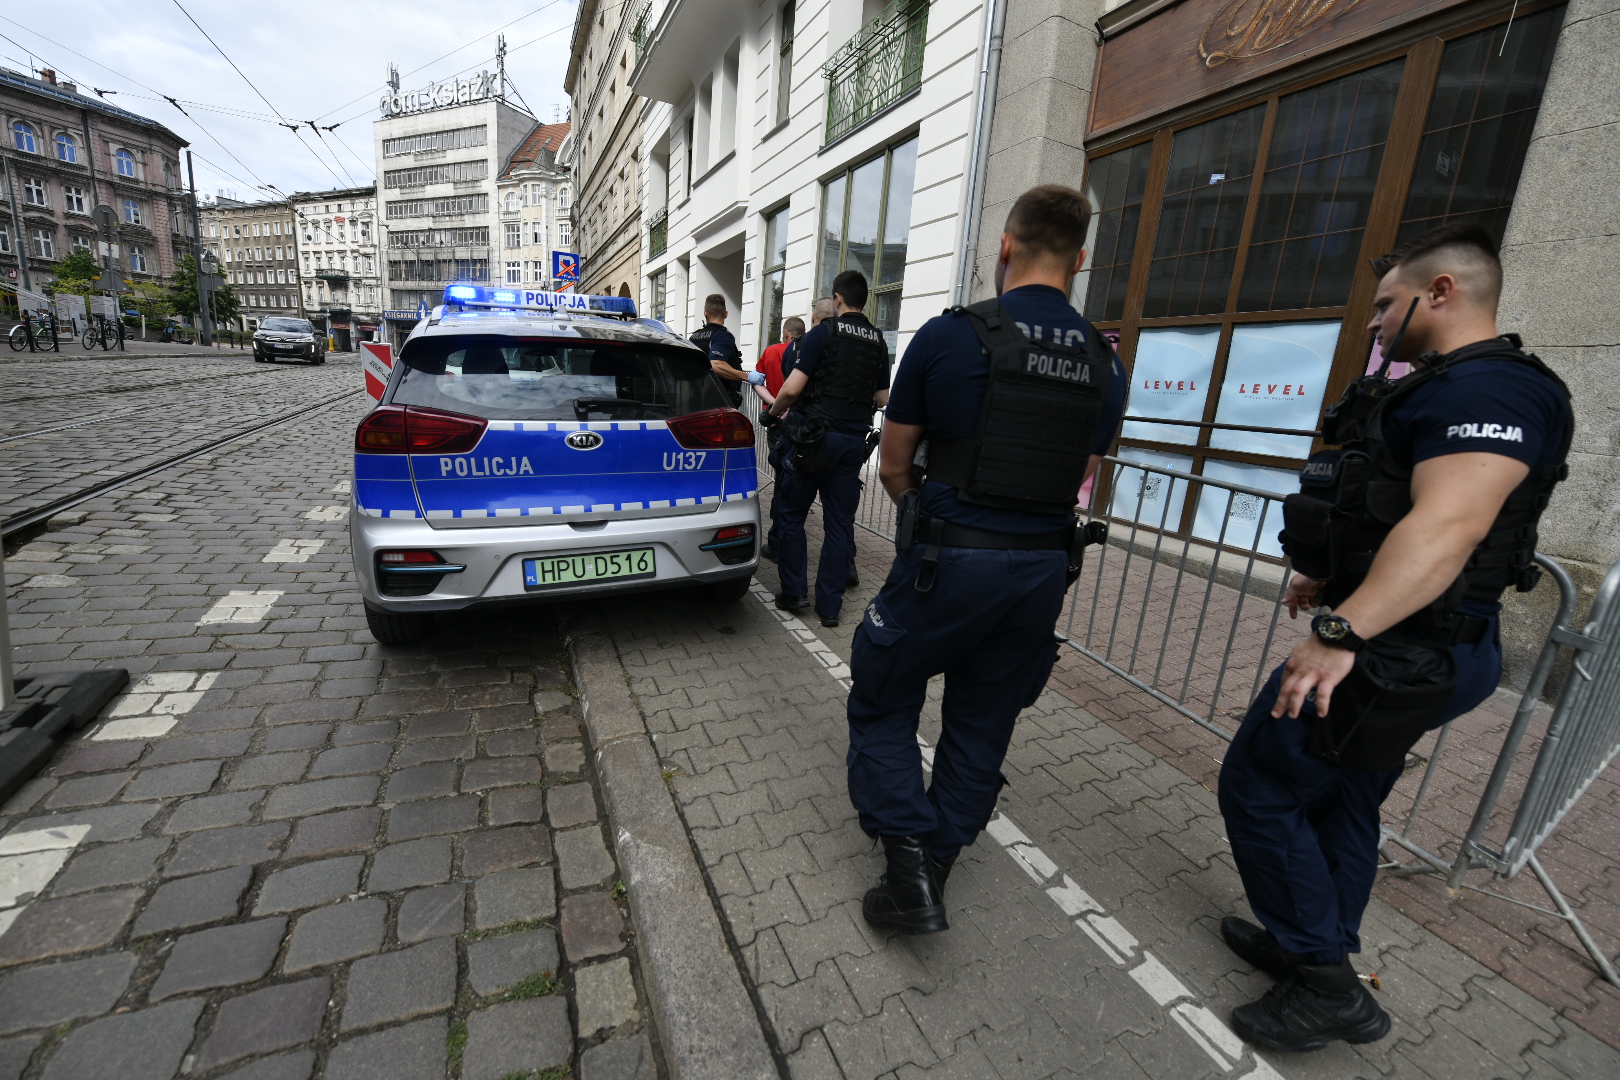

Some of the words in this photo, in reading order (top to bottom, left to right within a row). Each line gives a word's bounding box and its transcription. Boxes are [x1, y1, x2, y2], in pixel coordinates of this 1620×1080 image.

[526, 292, 587, 309] POLICJA
[837, 322, 879, 342] POLICJA
[1027, 353, 1090, 383] POLICJA
[1144, 380, 1197, 391] LEVEL
[1239, 383, 1305, 396] LEVEL
[572, 435, 596, 446] KIA
[1447, 424, 1524, 443] POLICJA
[440, 456, 534, 477] POLICJA
[662, 452, 707, 471] U137
[541, 557, 586, 582] HPU
[594, 552, 649, 577] D516
